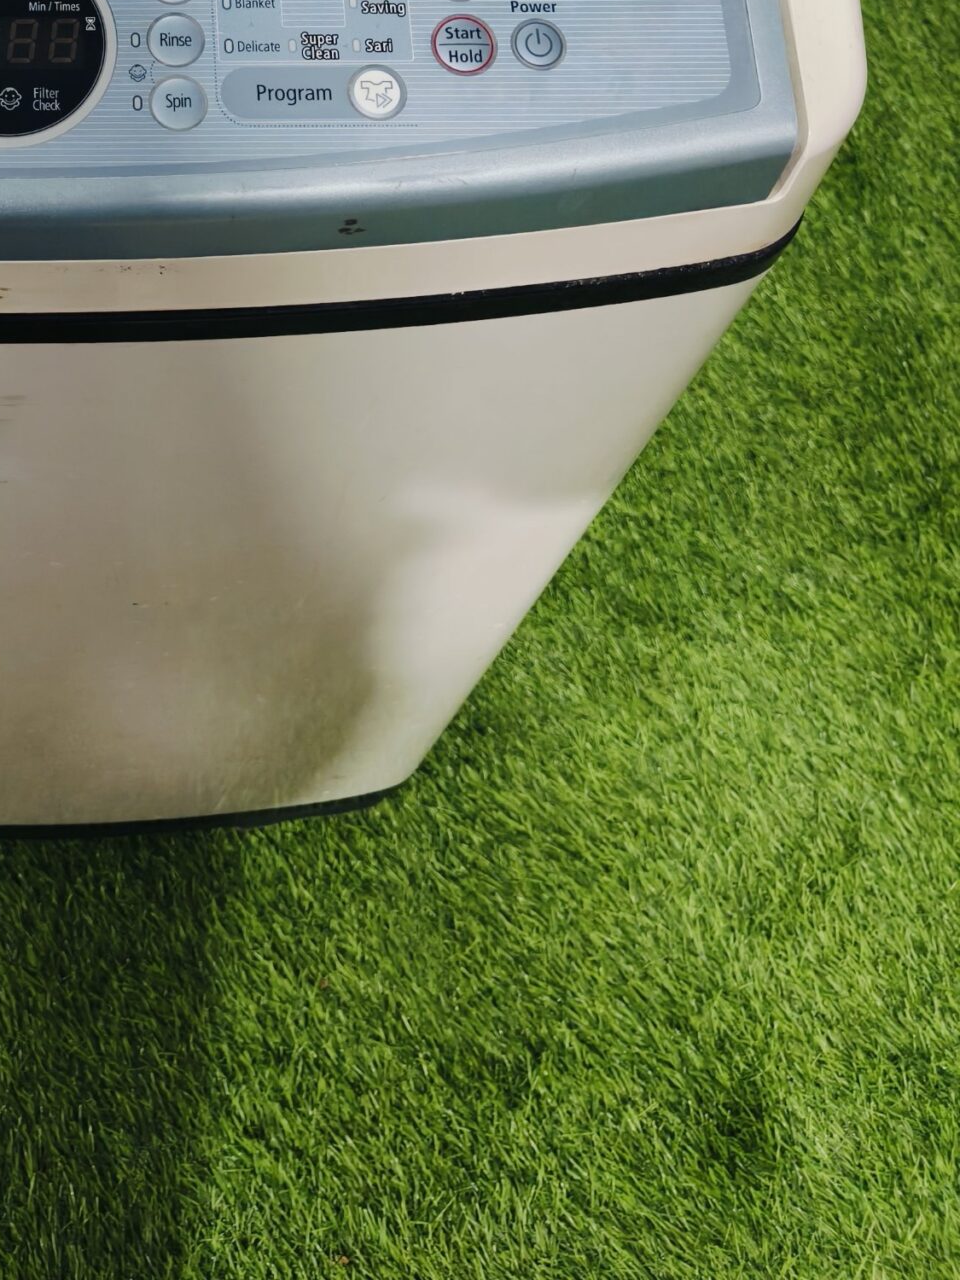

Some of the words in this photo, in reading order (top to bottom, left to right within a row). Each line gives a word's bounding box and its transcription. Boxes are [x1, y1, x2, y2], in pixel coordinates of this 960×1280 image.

[28, 2, 46, 12] Min
[54, 2, 81, 12] Times
[360, 0, 407, 17] Saving
[510, 0, 557, 13] Power
[159, 33, 192, 47] Rinse
[444, 26, 482, 40] Start
[237, 40, 281, 53] Delicate
[301, 32, 339, 49] Super
[364, 38, 394, 54] Sari
[302, 45, 340, 61] Clean
[448, 49, 483, 64] Hold
[33, 87, 60, 99] Filter
[256, 84, 333, 105] Program
[32, 100, 61, 112] Check
[165, 93, 192, 112] Spin
